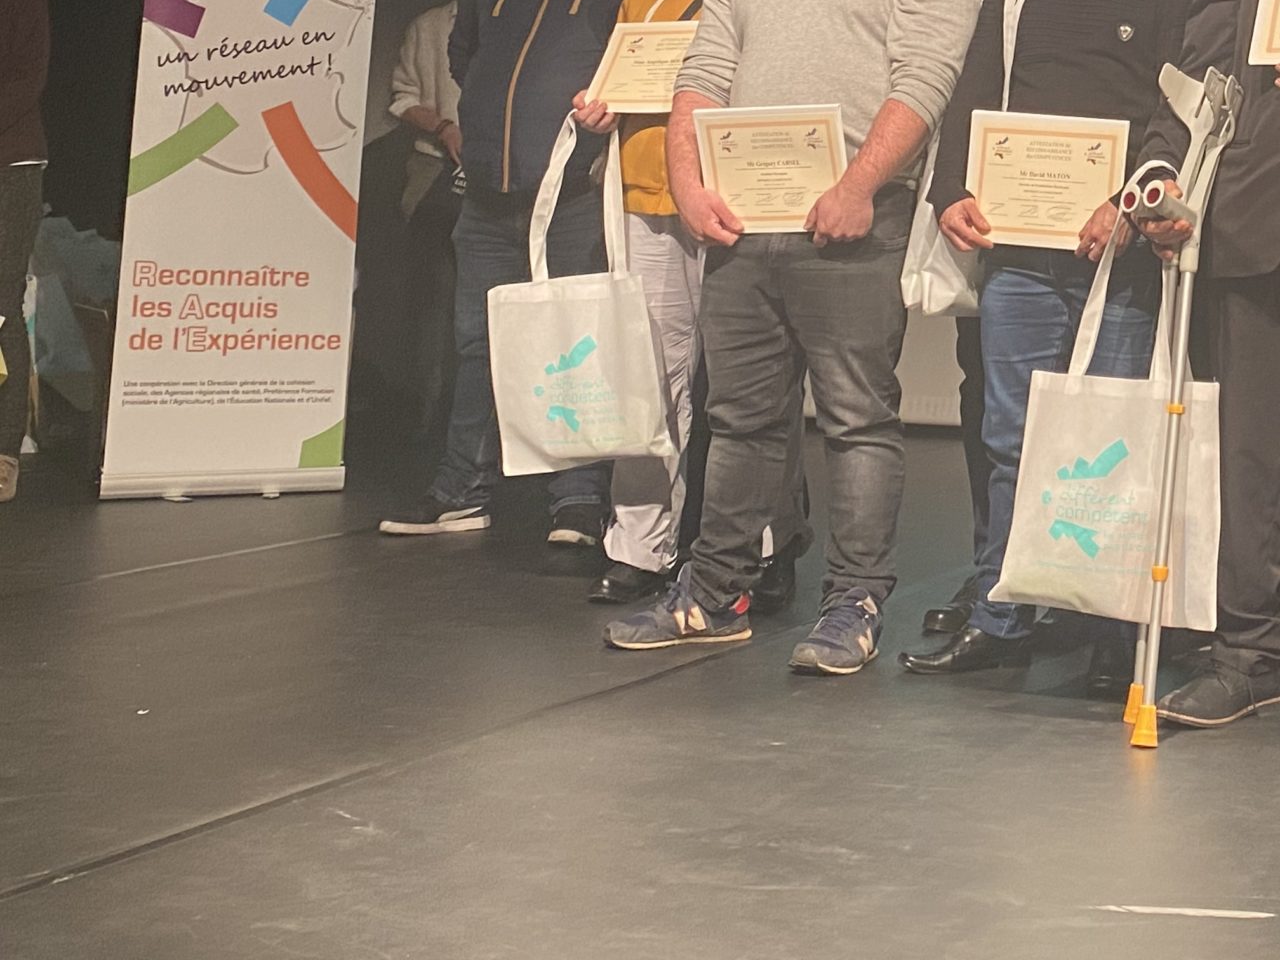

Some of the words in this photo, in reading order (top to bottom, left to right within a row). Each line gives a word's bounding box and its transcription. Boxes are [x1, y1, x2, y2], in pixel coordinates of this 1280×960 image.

[157, 52, 199, 68] un
[207, 35, 295, 61] réseau
[301, 31, 336, 46] en
[164, 56, 322, 97] mouvement
[132, 260, 310, 287] Reconnaître
[131, 294, 172, 318] les
[178, 293, 279, 324] Acquis
[128, 327, 163, 350] de
[173, 326, 342, 357] l'Expérience
